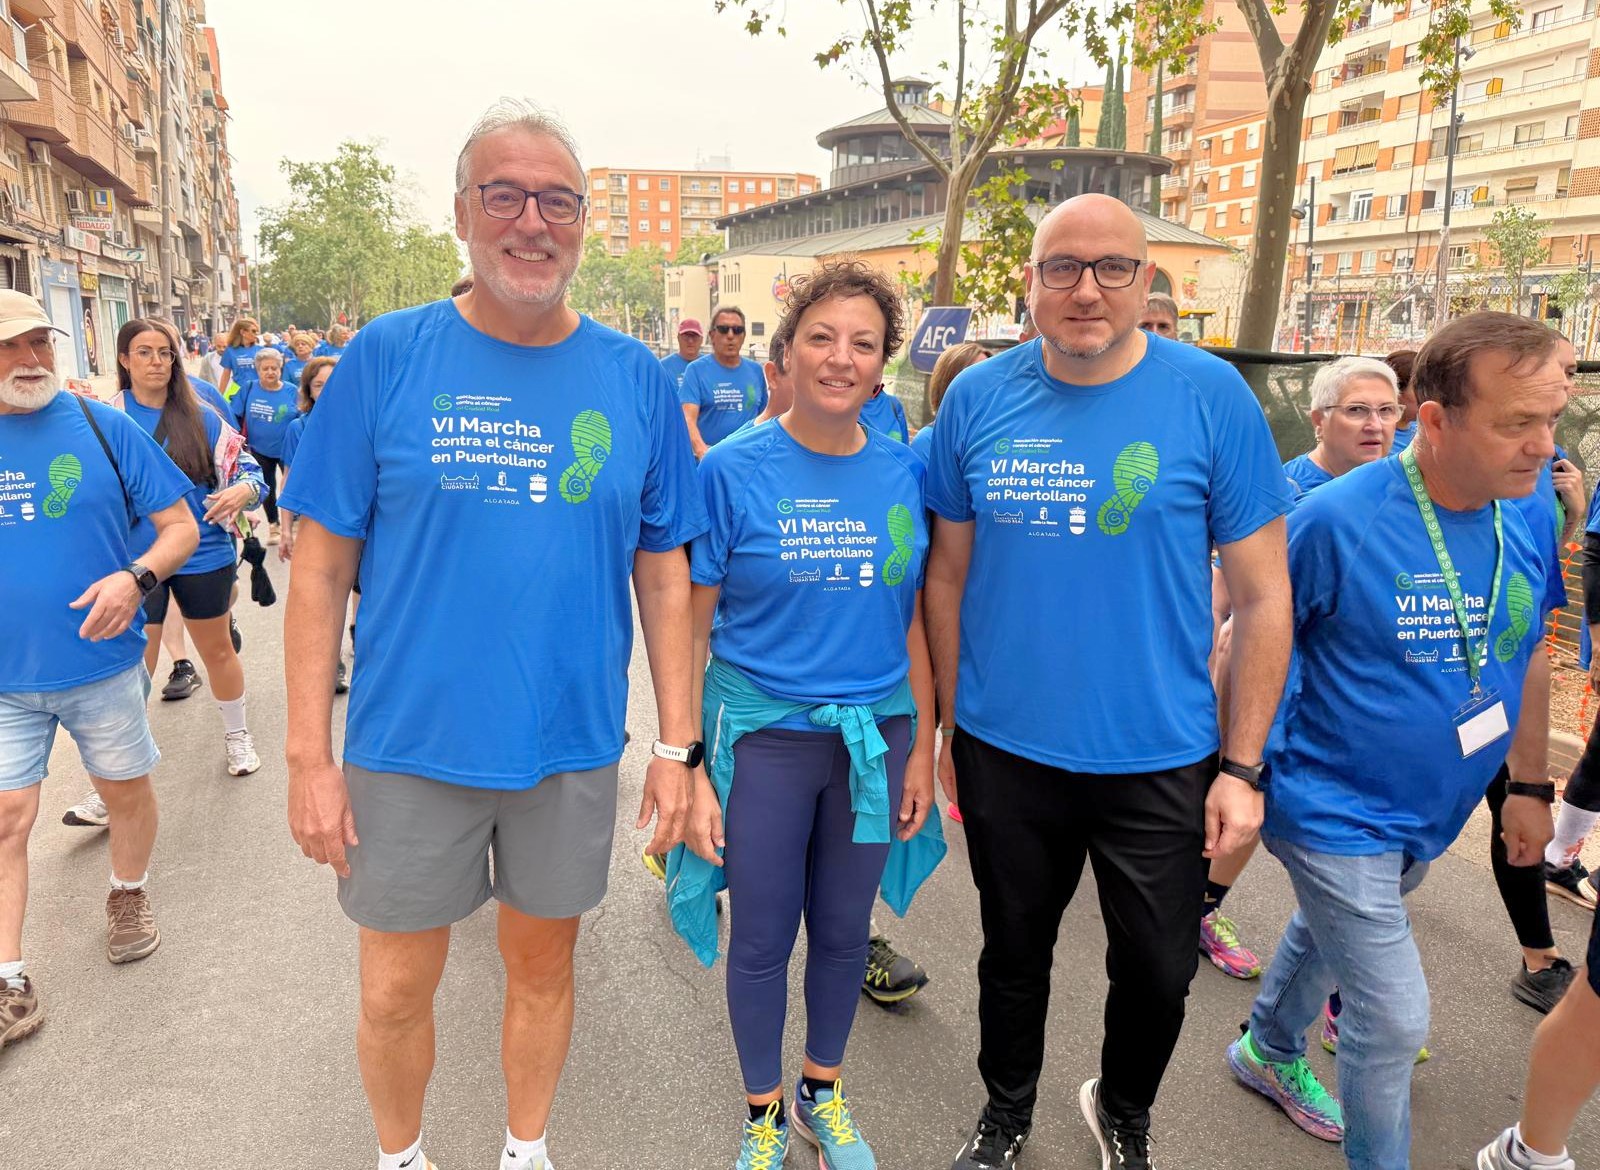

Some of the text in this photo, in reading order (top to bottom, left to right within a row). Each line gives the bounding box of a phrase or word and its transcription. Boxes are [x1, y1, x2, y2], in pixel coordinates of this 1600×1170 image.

[77, 222, 111, 230] HIDALGO
[919, 326, 956, 350] AFC
[431, 416, 542, 438] VI Marcha
[431, 435, 555, 454] contra el cáncer
[431, 450, 547, 469] en Puertollano
[990, 459, 1085, 475] VI Marcha
[987, 476, 1096, 488] contra el cáncer
[986, 489, 1087, 503] en Puertollano
[778, 517, 867, 534] VI Marcha
[780, 534, 878, 547] contra el cáncer
[780, 548, 874, 561] en Puertollano
[1395, 595, 1416, 611] VI
[1397, 613, 1441, 625] contra
[1444, 612, 1456, 624] el
[1397, 627, 1487, 640] en Puertoano
